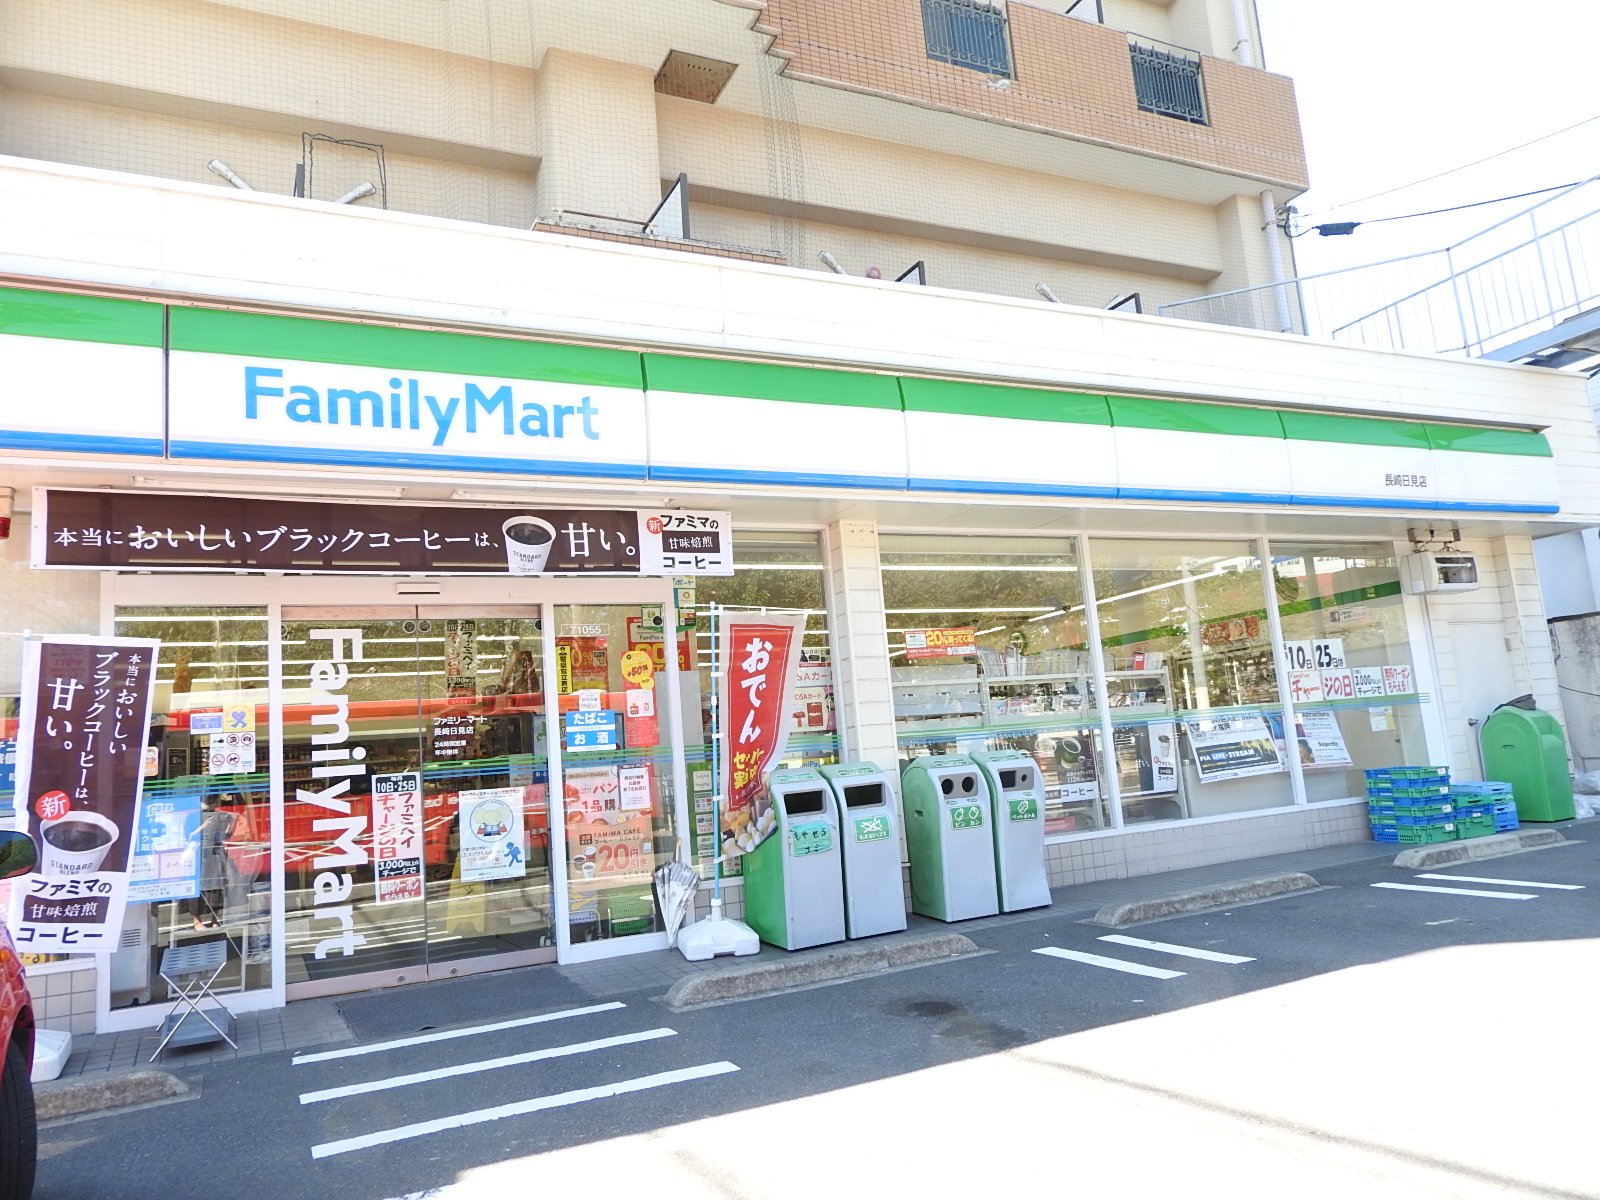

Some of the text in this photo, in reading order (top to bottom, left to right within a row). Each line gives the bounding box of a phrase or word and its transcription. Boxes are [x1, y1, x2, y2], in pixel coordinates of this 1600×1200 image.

[245, 366, 600, 446] FamilyMart
[1385, 474, 1427, 487] 長崎日見店
[54, 522, 636, 558] 本当においしいブラックコーヒーは、 甘い。
[668, 535, 714, 550] 甘味焙煎
[663, 556, 722, 570] コーヒー
[570, 625, 602, 634] 71055
[1288, 646, 1313, 669] 10日
[740, 638, 773, 744] おでん
[109, 653, 142, 754] 本当においしい
[46, 677, 84, 750] 甘い。
[433, 715, 487, 726] ファミリーマート
[573, 712, 608, 725] たばこ
[74, 651, 119, 805] ブラックコーヒーは、
[433, 726, 474, 736] 長崎日見店
[296, 628, 369, 960] FamilyMart
[593, 783, 618, 794] パン
[1062, 787, 1094, 797] コーヒー
[41, 794, 66, 815] 新
[50, 858, 94, 873] STANDARD
[31, 878, 112, 896] ファミマの
[30, 901, 98, 919] 甘味焙煎
[16, 926, 103, 944] コーヒー
